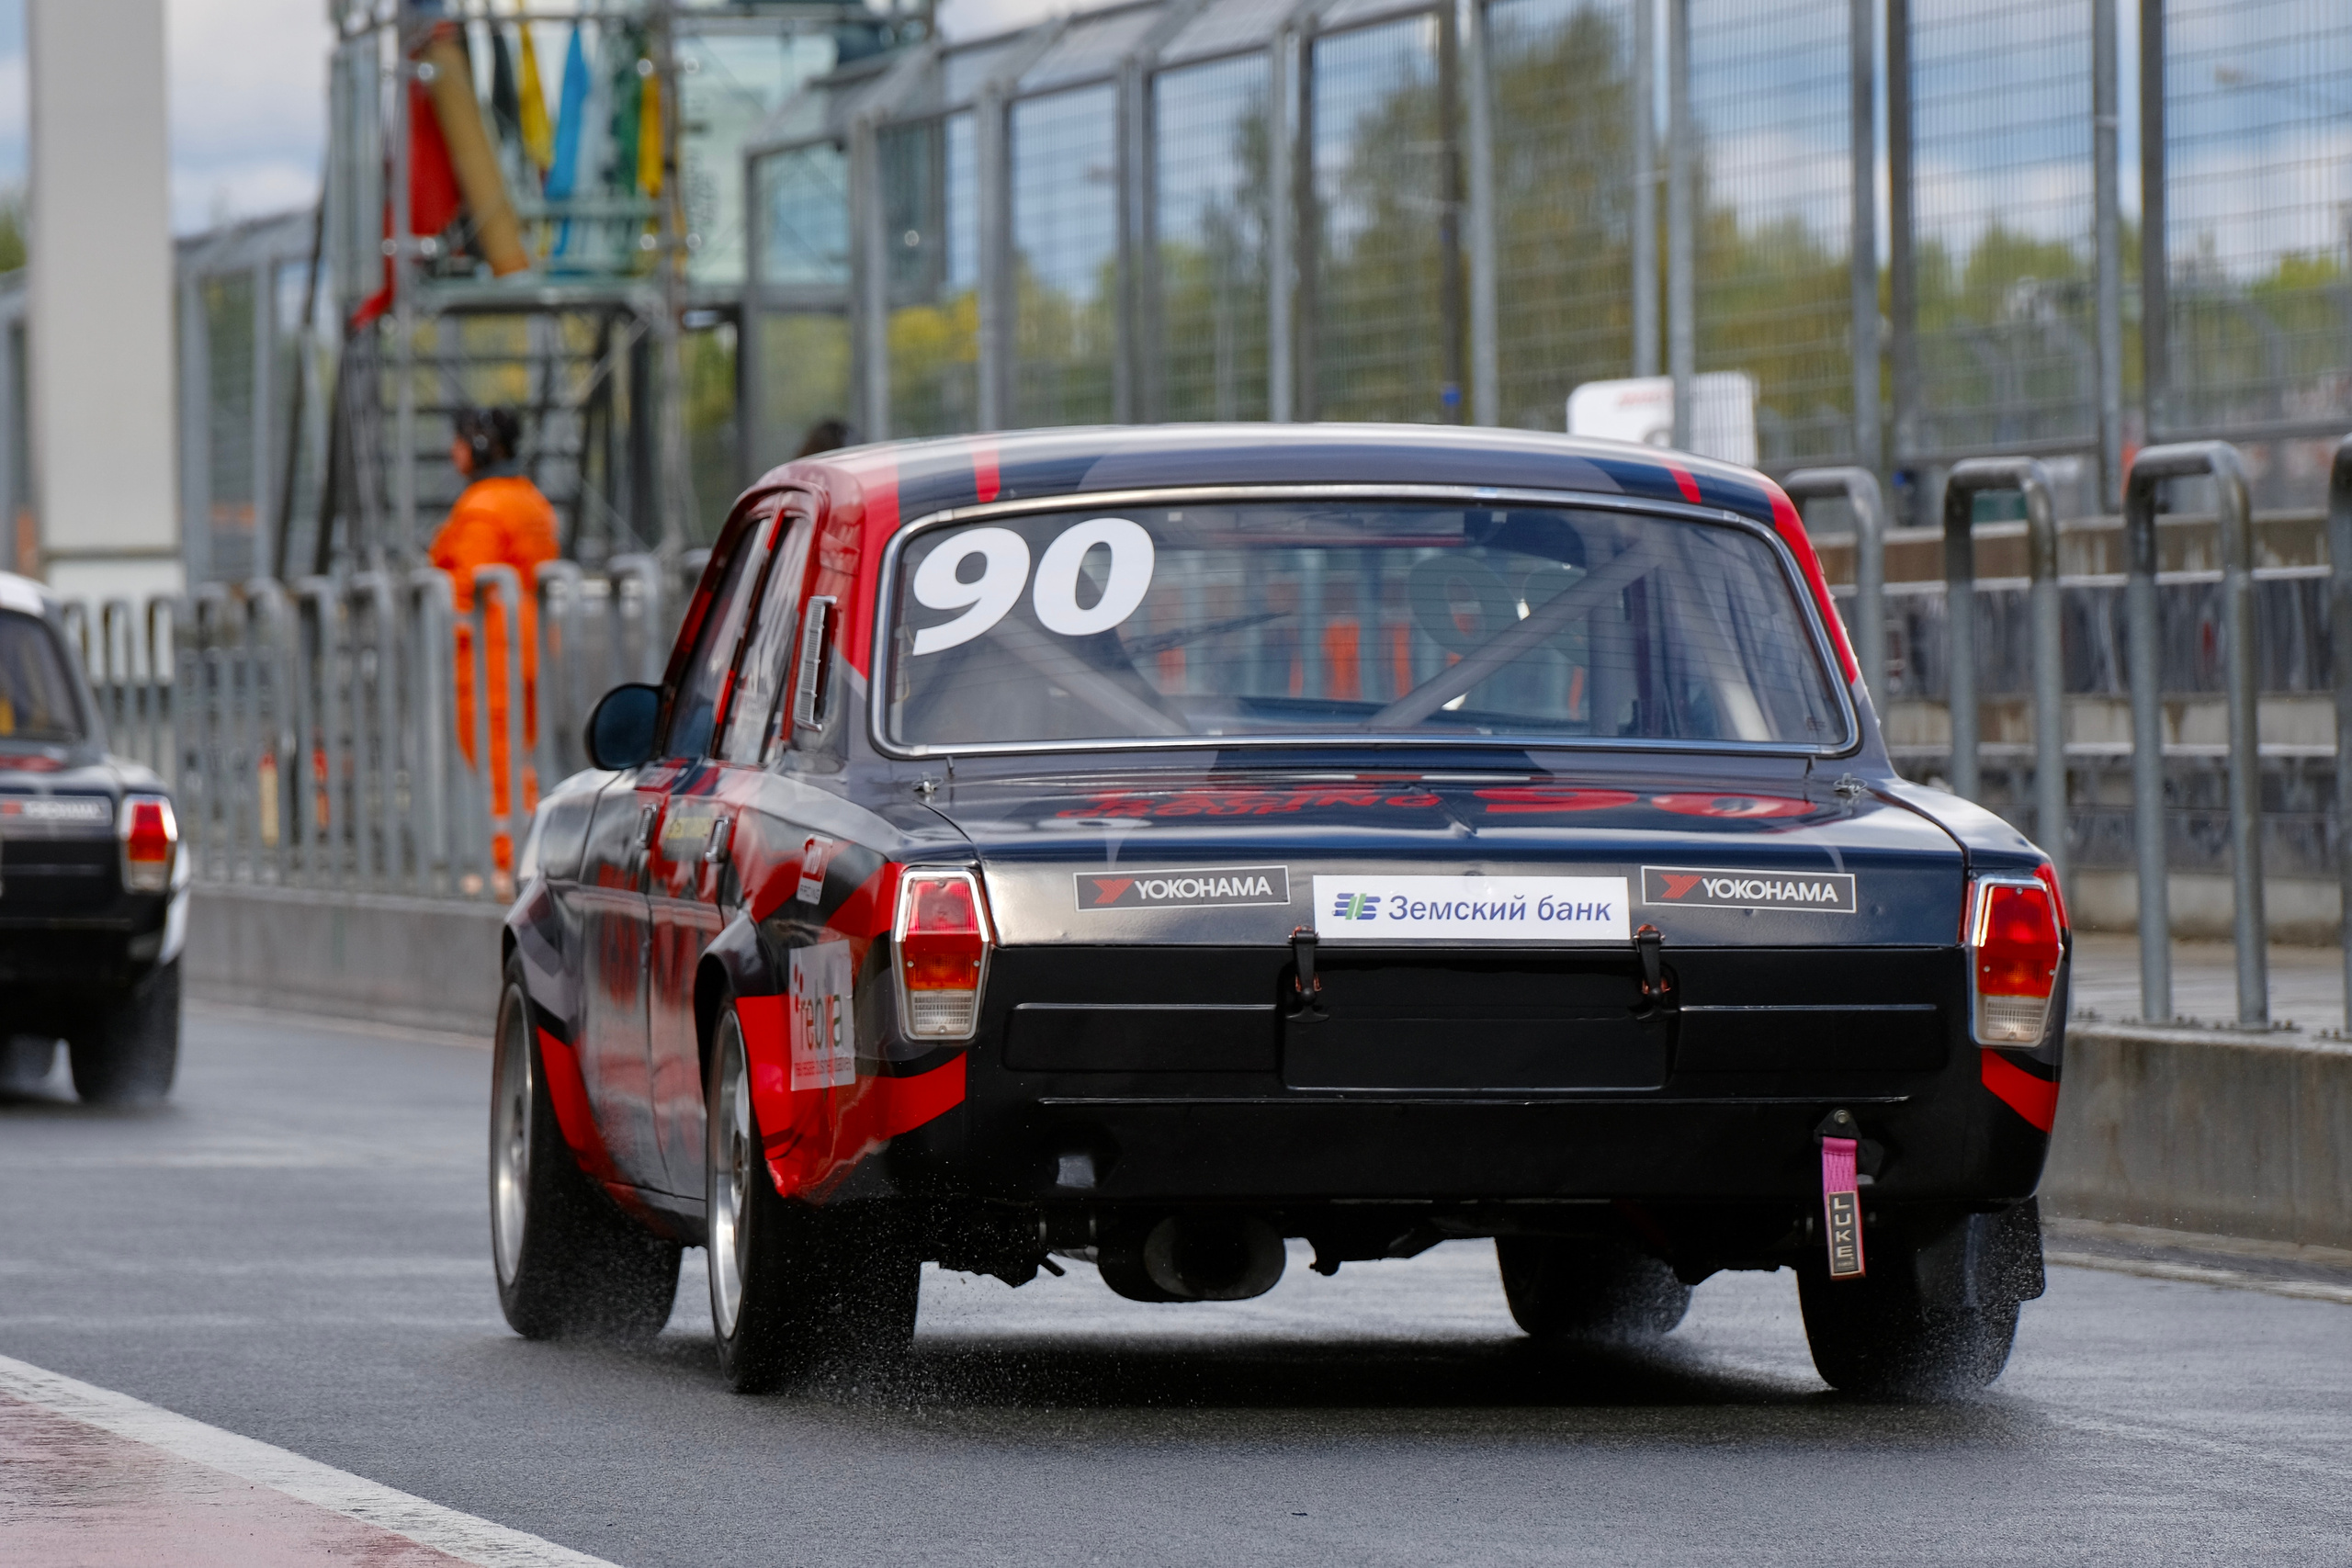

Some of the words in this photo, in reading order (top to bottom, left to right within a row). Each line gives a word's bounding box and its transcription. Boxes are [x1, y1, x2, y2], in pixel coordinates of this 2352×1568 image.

[912, 517, 1155, 656] 90
[1473, 787, 1818, 818] 90
[1135, 876, 1273, 899] YOKOHAMA
[1702, 878, 1838, 902] YOKOHAMA
[1388, 894, 1526, 920] Земский
[1537, 895, 1612, 921] банк
[1834, 1197, 1853, 1258] LUKE
